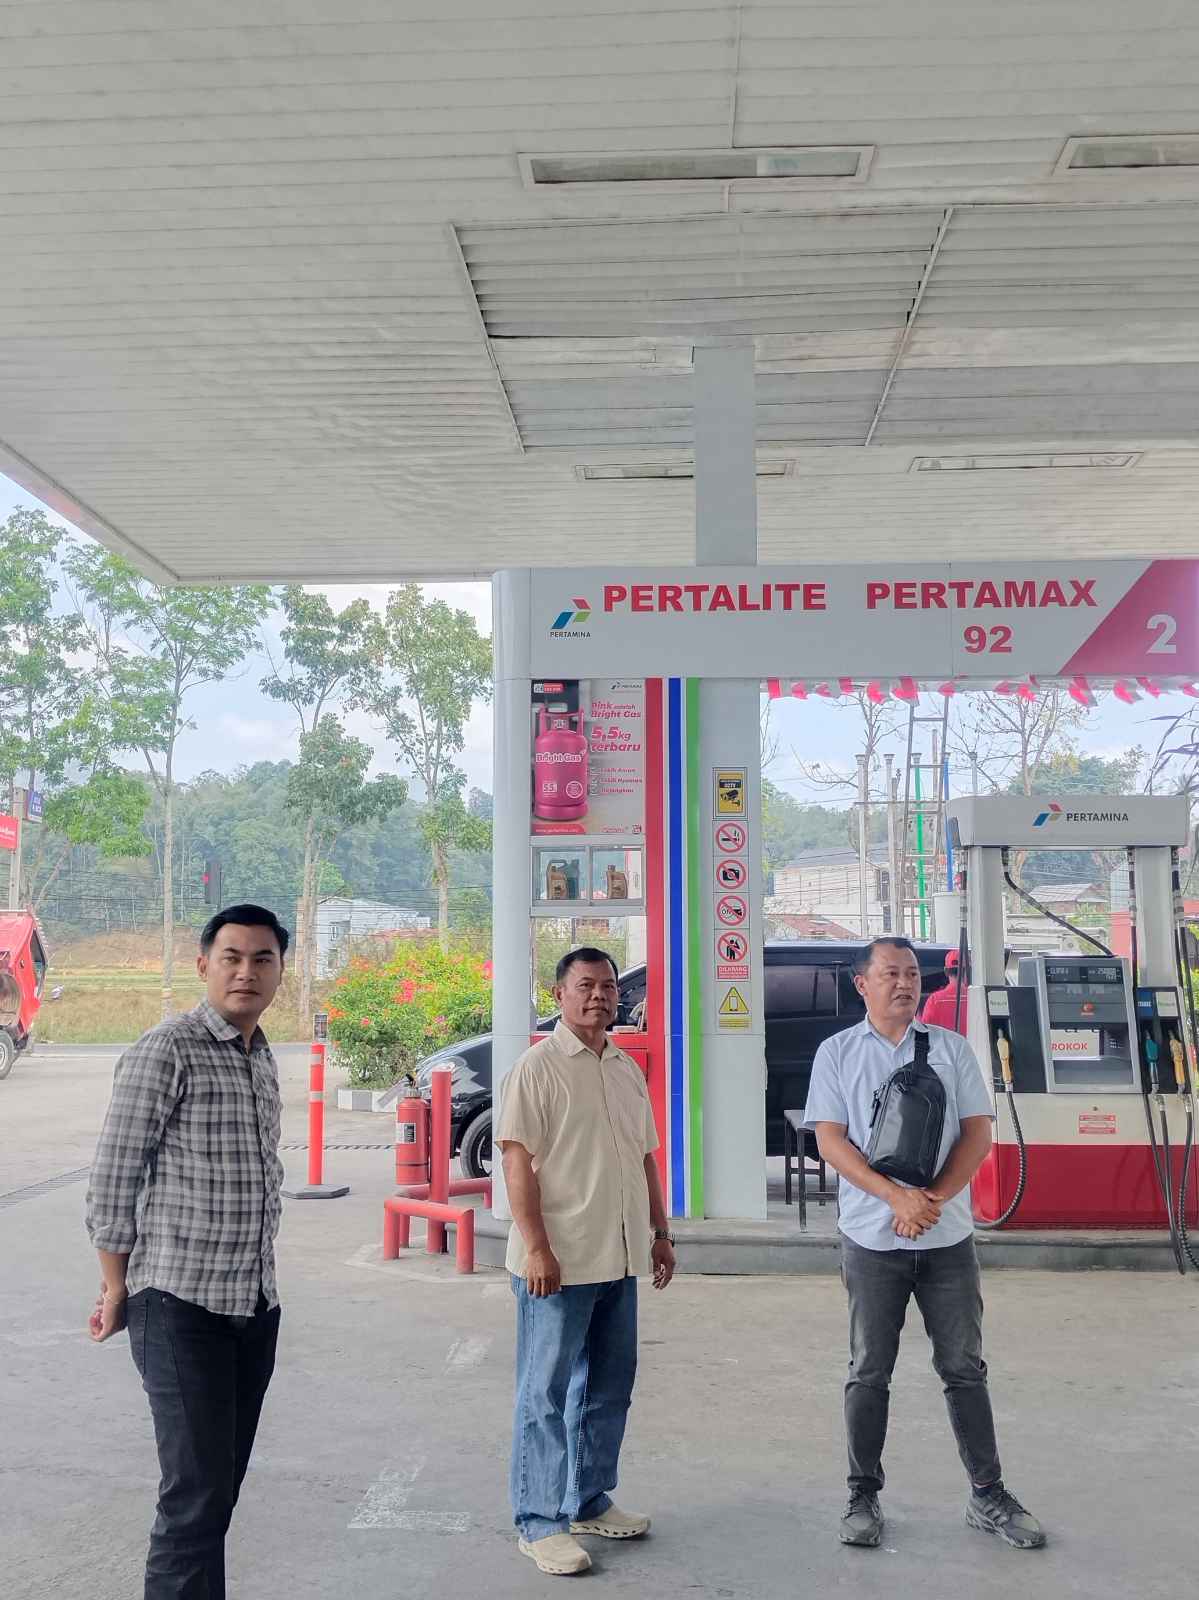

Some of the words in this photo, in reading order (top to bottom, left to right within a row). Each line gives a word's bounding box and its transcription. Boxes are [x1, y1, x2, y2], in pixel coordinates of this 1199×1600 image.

[603, 584, 827, 612] PERTALITE
[866, 580, 1099, 609] PERTAMAX
[963, 625, 1013, 653] 92
[1146, 614, 1177, 655] 2
[624, 710, 641, 718] Gas
[1066, 812, 1129, 822] PERTAMINA
[1051, 1042, 1089, 1052] ROKOK
